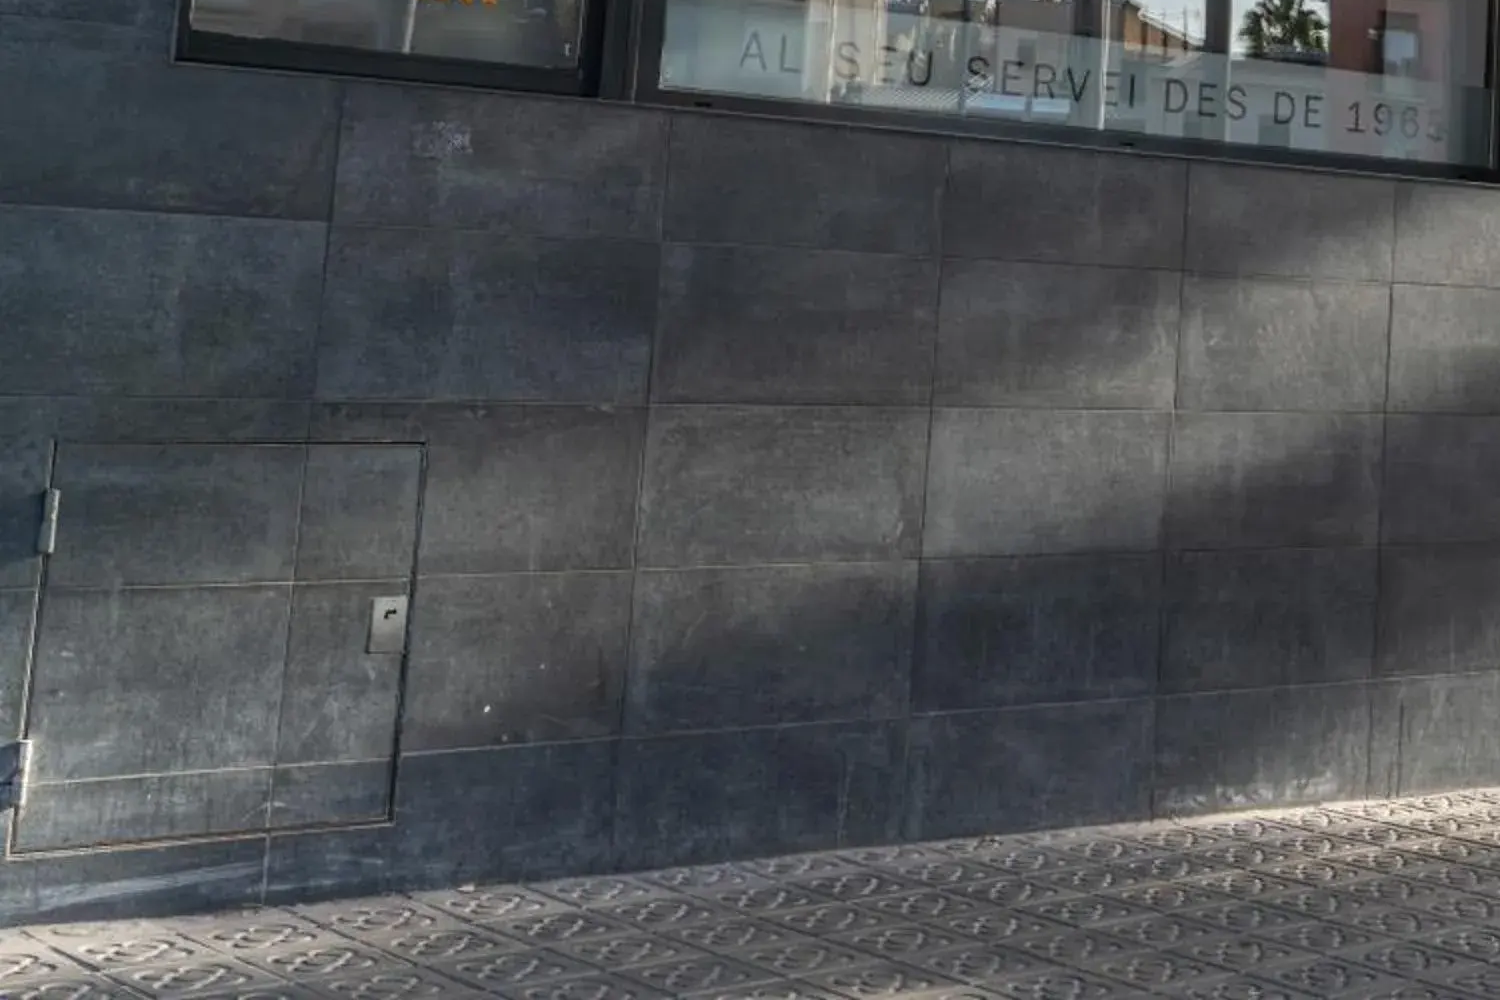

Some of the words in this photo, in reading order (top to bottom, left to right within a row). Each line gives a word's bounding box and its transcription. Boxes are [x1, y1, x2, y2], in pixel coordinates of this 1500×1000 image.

[739, 28, 801, 74] AL
[835, 40, 934, 88] SEU
[963, 55, 1137, 110] SERVEI
[1164, 77, 1249, 121] DES
[1273, 90, 1325, 129] DE
